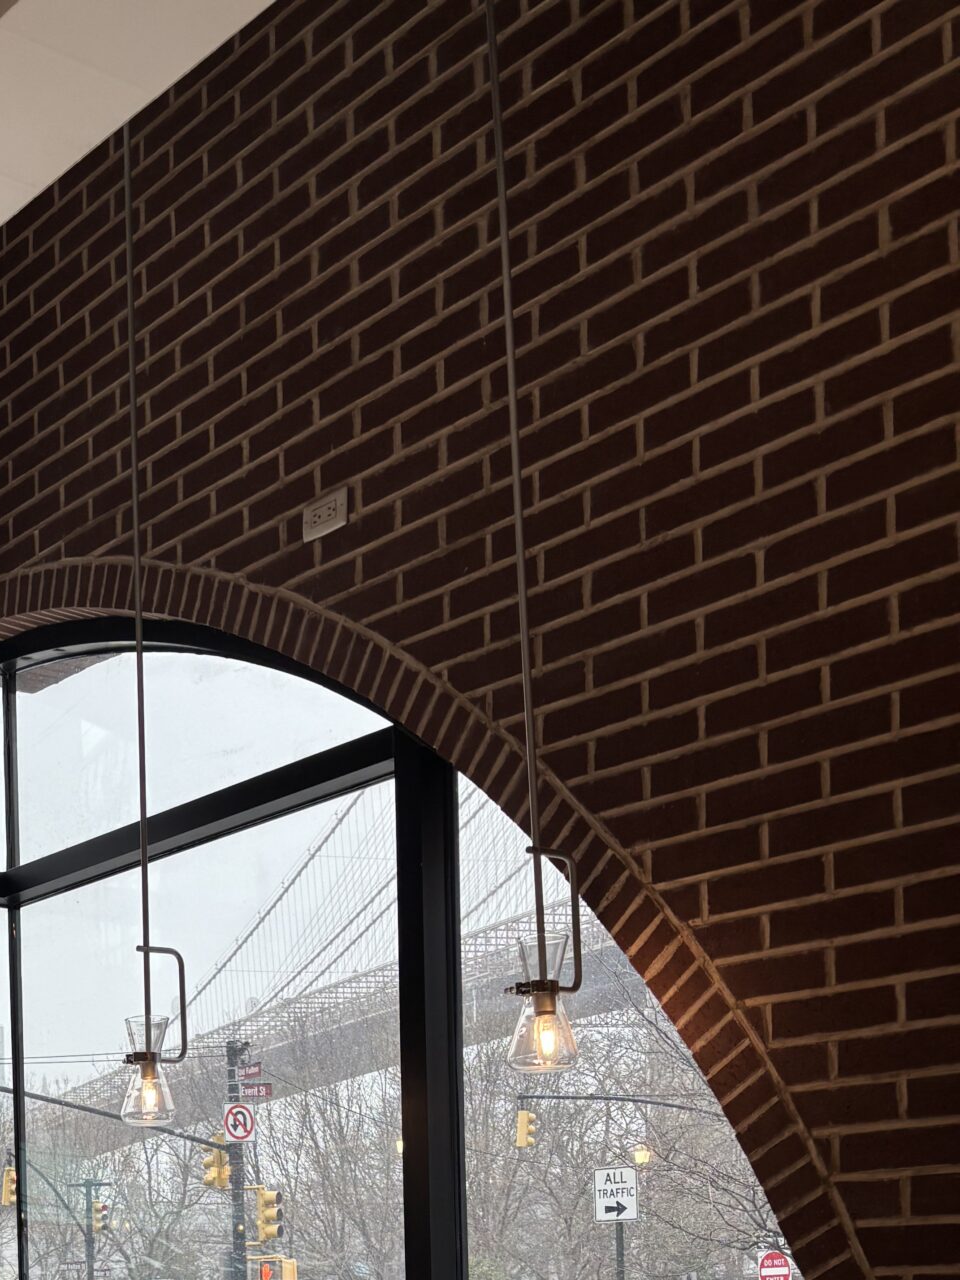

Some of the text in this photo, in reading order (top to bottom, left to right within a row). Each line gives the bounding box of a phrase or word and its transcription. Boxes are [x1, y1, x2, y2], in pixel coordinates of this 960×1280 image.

[259, 1086, 266, 1096] St
[605, 1172, 628, 1185] ALL
[597, 1186, 635, 1199] TRAFFIC
